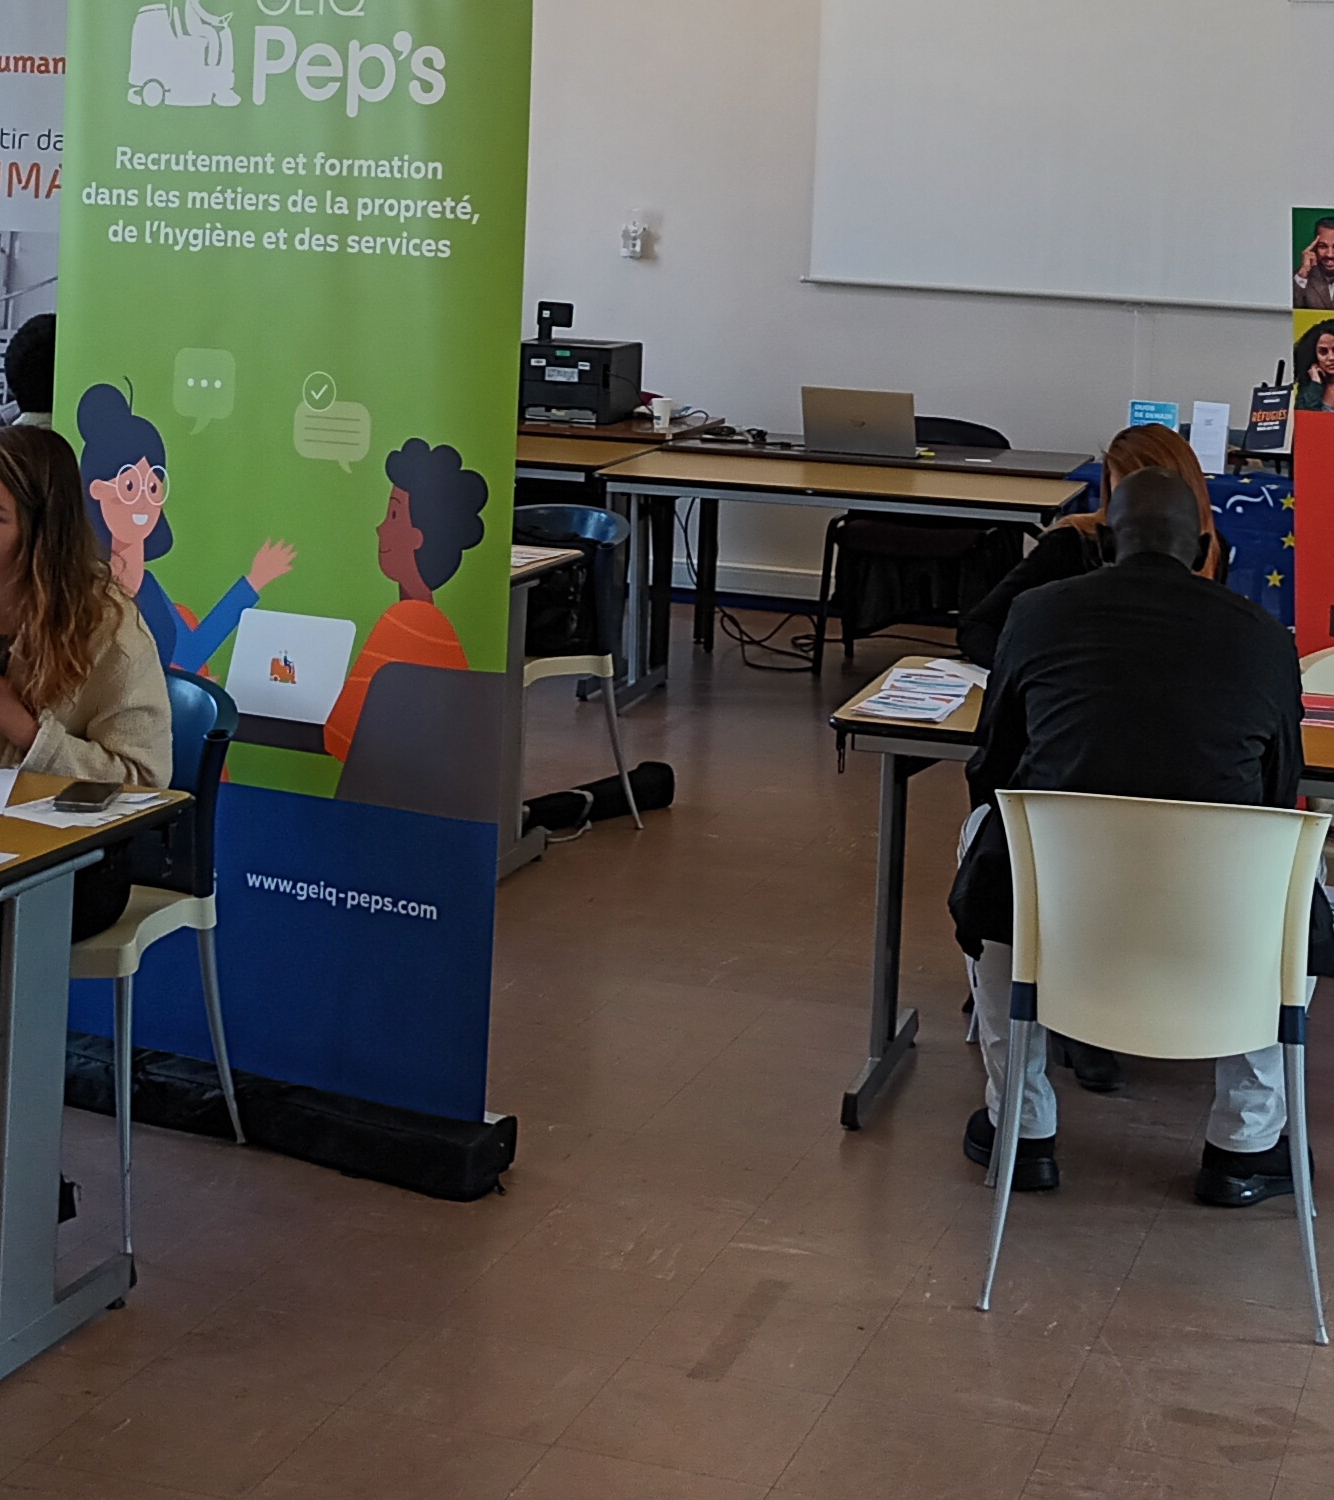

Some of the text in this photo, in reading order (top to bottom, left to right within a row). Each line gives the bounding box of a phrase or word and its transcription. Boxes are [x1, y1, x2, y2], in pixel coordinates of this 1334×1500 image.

[252, 25, 446, 118] Pep's
[115, 146, 443, 180] Recrutement et formation
[81, 182, 480, 225] dans les métiers de la propreté,
[108, 219, 451, 258] de l'hygiène et des services
[246, 872, 438, 920] www.geiq-peps.com
